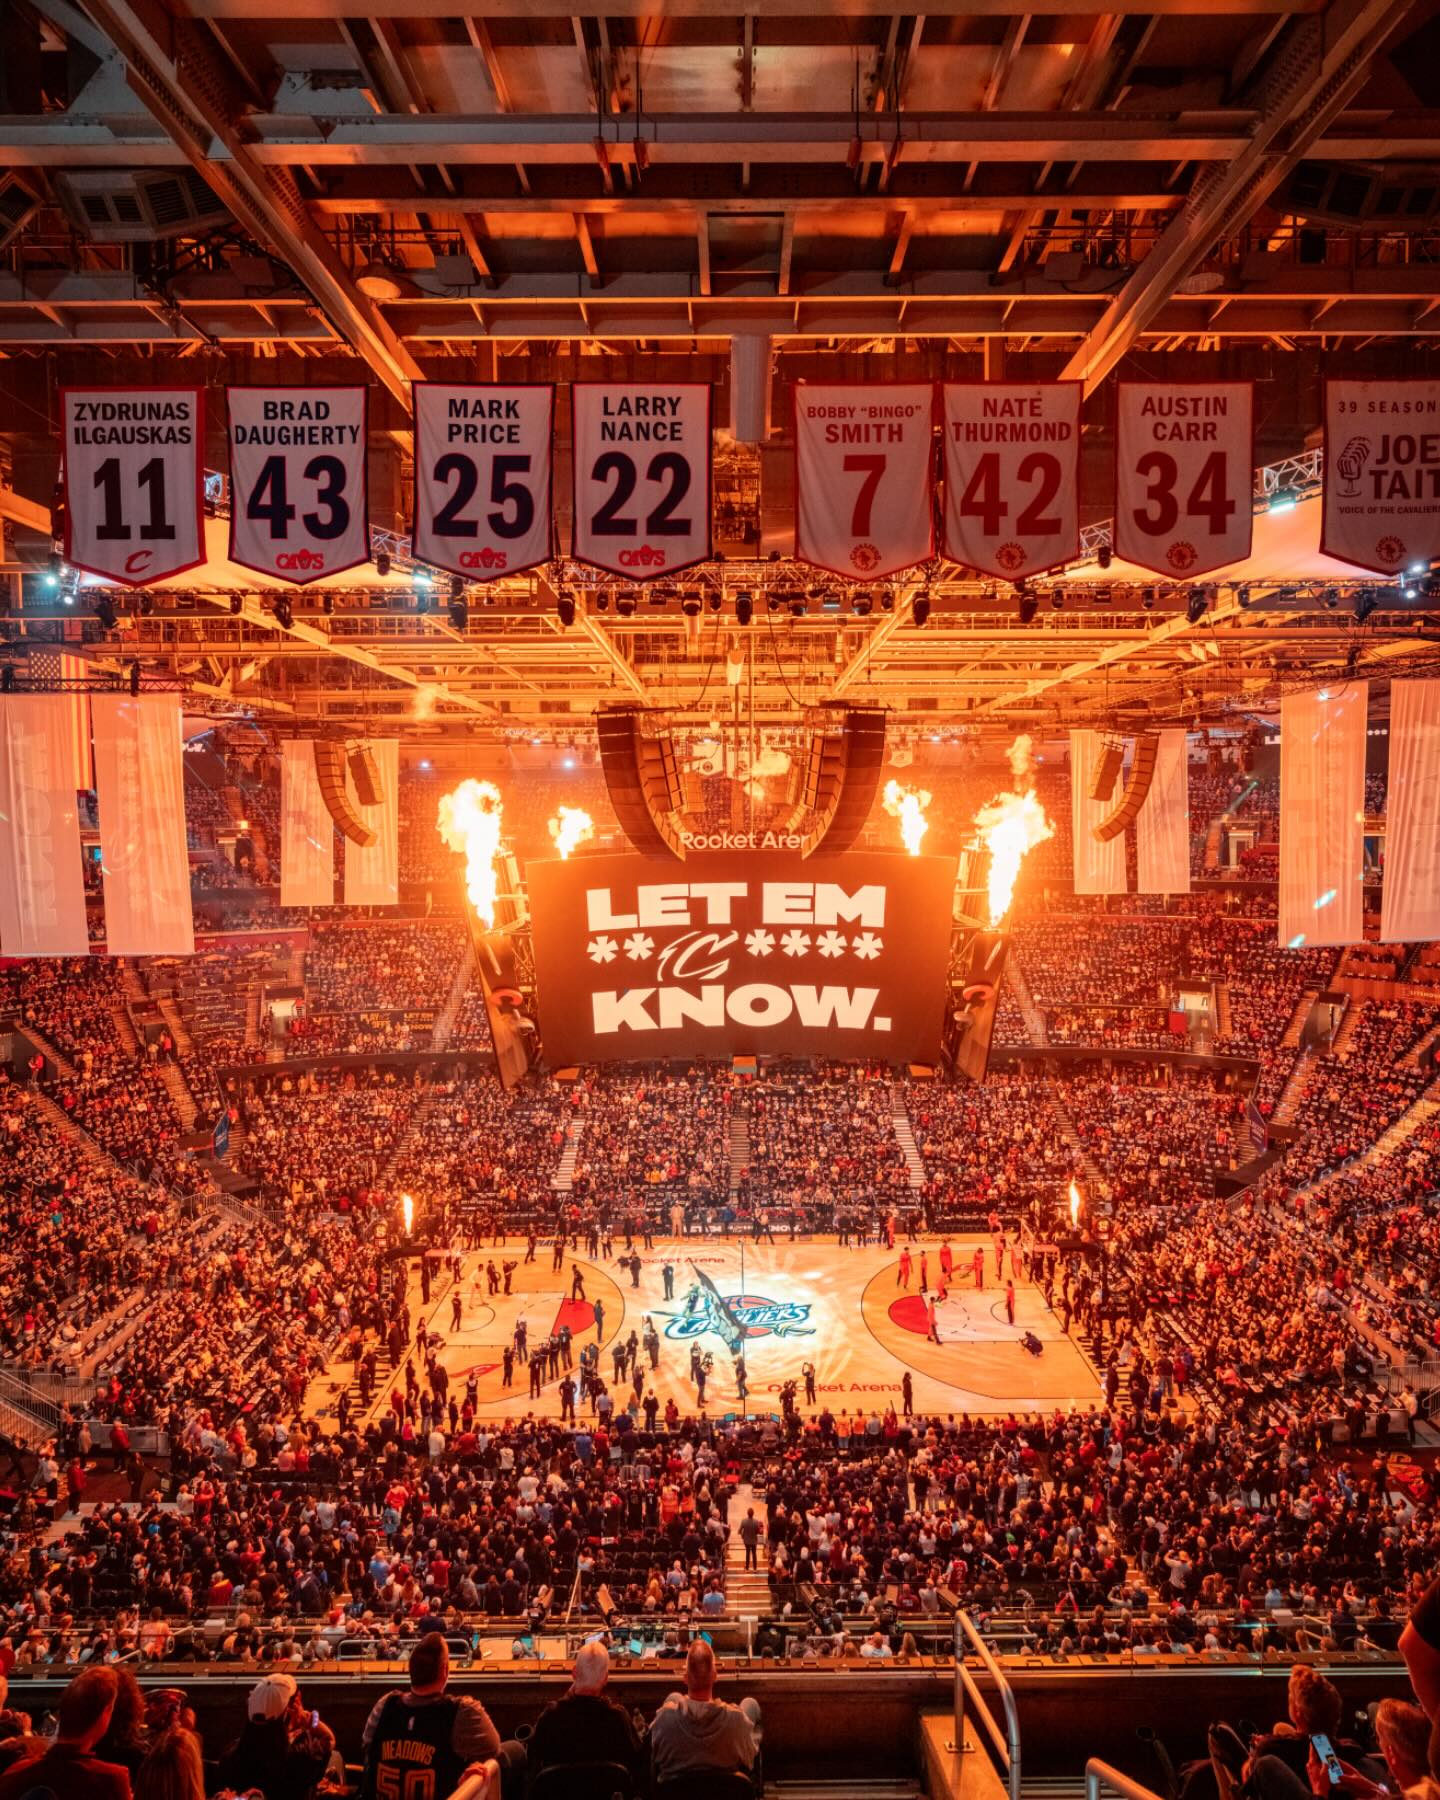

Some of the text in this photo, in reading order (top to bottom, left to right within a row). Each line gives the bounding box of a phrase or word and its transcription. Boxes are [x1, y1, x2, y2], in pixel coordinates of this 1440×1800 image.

[74, 402, 190, 421] ZYDRUNAS
[263, 401, 330, 420] BRAD
[447, 398, 520, 419] MARK
[603, 396, 682, 417] LARRY
[807, 406, 856, 419] BOBBY
[983, 398, 1043, 418] NATE
[1141, 396, 1227, 417] AUSTIN
[1338, 400, 1437, 414] 39 SEASON
[74, 425, 192, 445] ILGAUSKAS
[235, 425, 361, 445] DAUGHERTY
[447, 423, 521, 444] PRICE
[600, 421, 683, 442] NANCE
[825, 423, 904, 444] SMITH
[952, 421, 1072, 443] THURMOND
[1152, 421, 1217, 442] CARR
[1375, 434, 1440, 466] JOE
[590, 451, 692, 537] 22
[959, 452, 1063, 537] 42
[1133, 451, 1236, 537] 34
[1368, 469, 1440, 500] TAIT
[94, 457, 176, 541] 11
[247, 455, 351, 541] 43
[431, 452, 535, 539] 25
[842, 454, 887, 537] 7
[1367, 505, 1378, 515] OF
[1379, 505, 1395, 515] THE
[680, 832, 757, 849] Rocket
[586, 882, 887, 931] LET EM
[591, 984, 892, 1034] KNOW.
[850, 1383, 902, 1393] Arena
[382, 1739, 436, 1766] MEADOWS
[376, 1761, 436, 1800] 50
